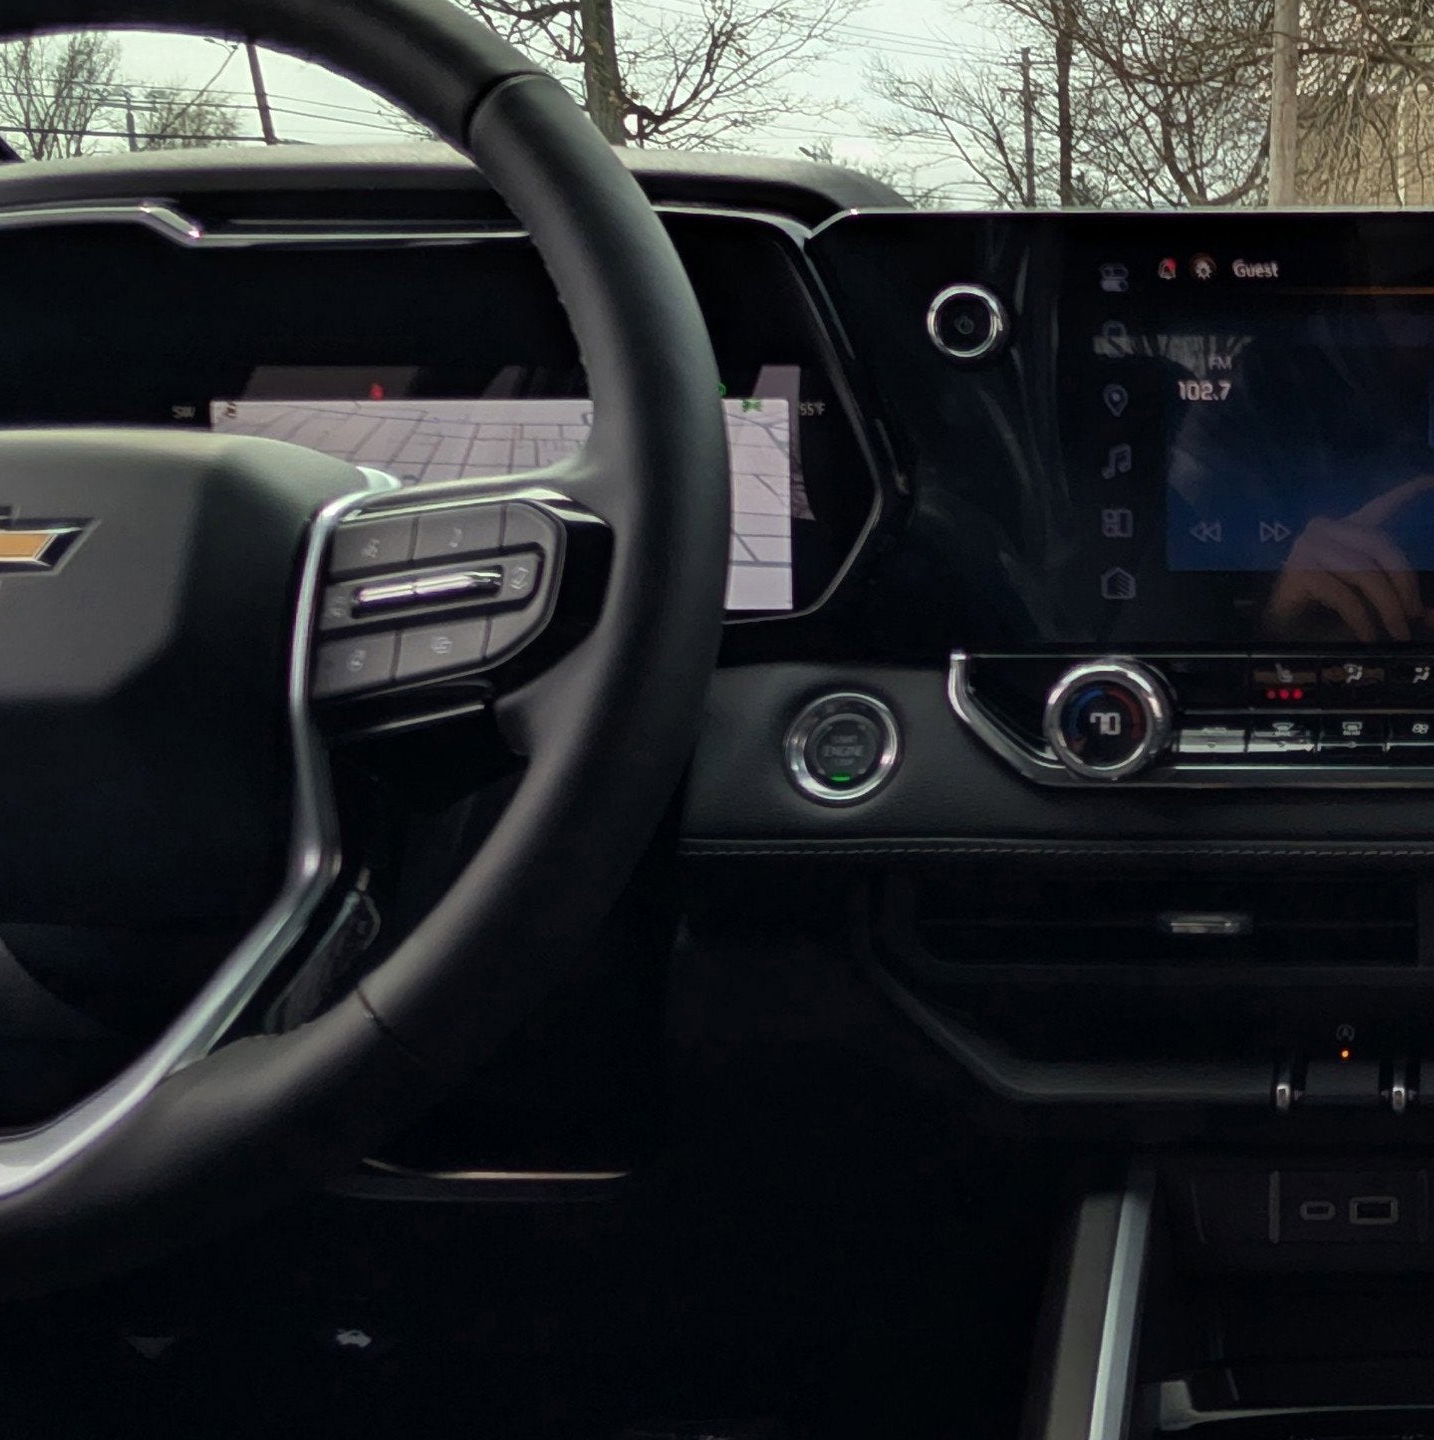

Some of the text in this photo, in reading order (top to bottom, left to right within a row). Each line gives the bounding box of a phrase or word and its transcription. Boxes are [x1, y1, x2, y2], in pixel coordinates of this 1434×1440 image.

[1231, 258, 1279, 278] Guest
[1208, 356, 1232, 370] FM
[1177, 380, 1231, 401] 102.7
[1089, 711, 1121, 735] 70
